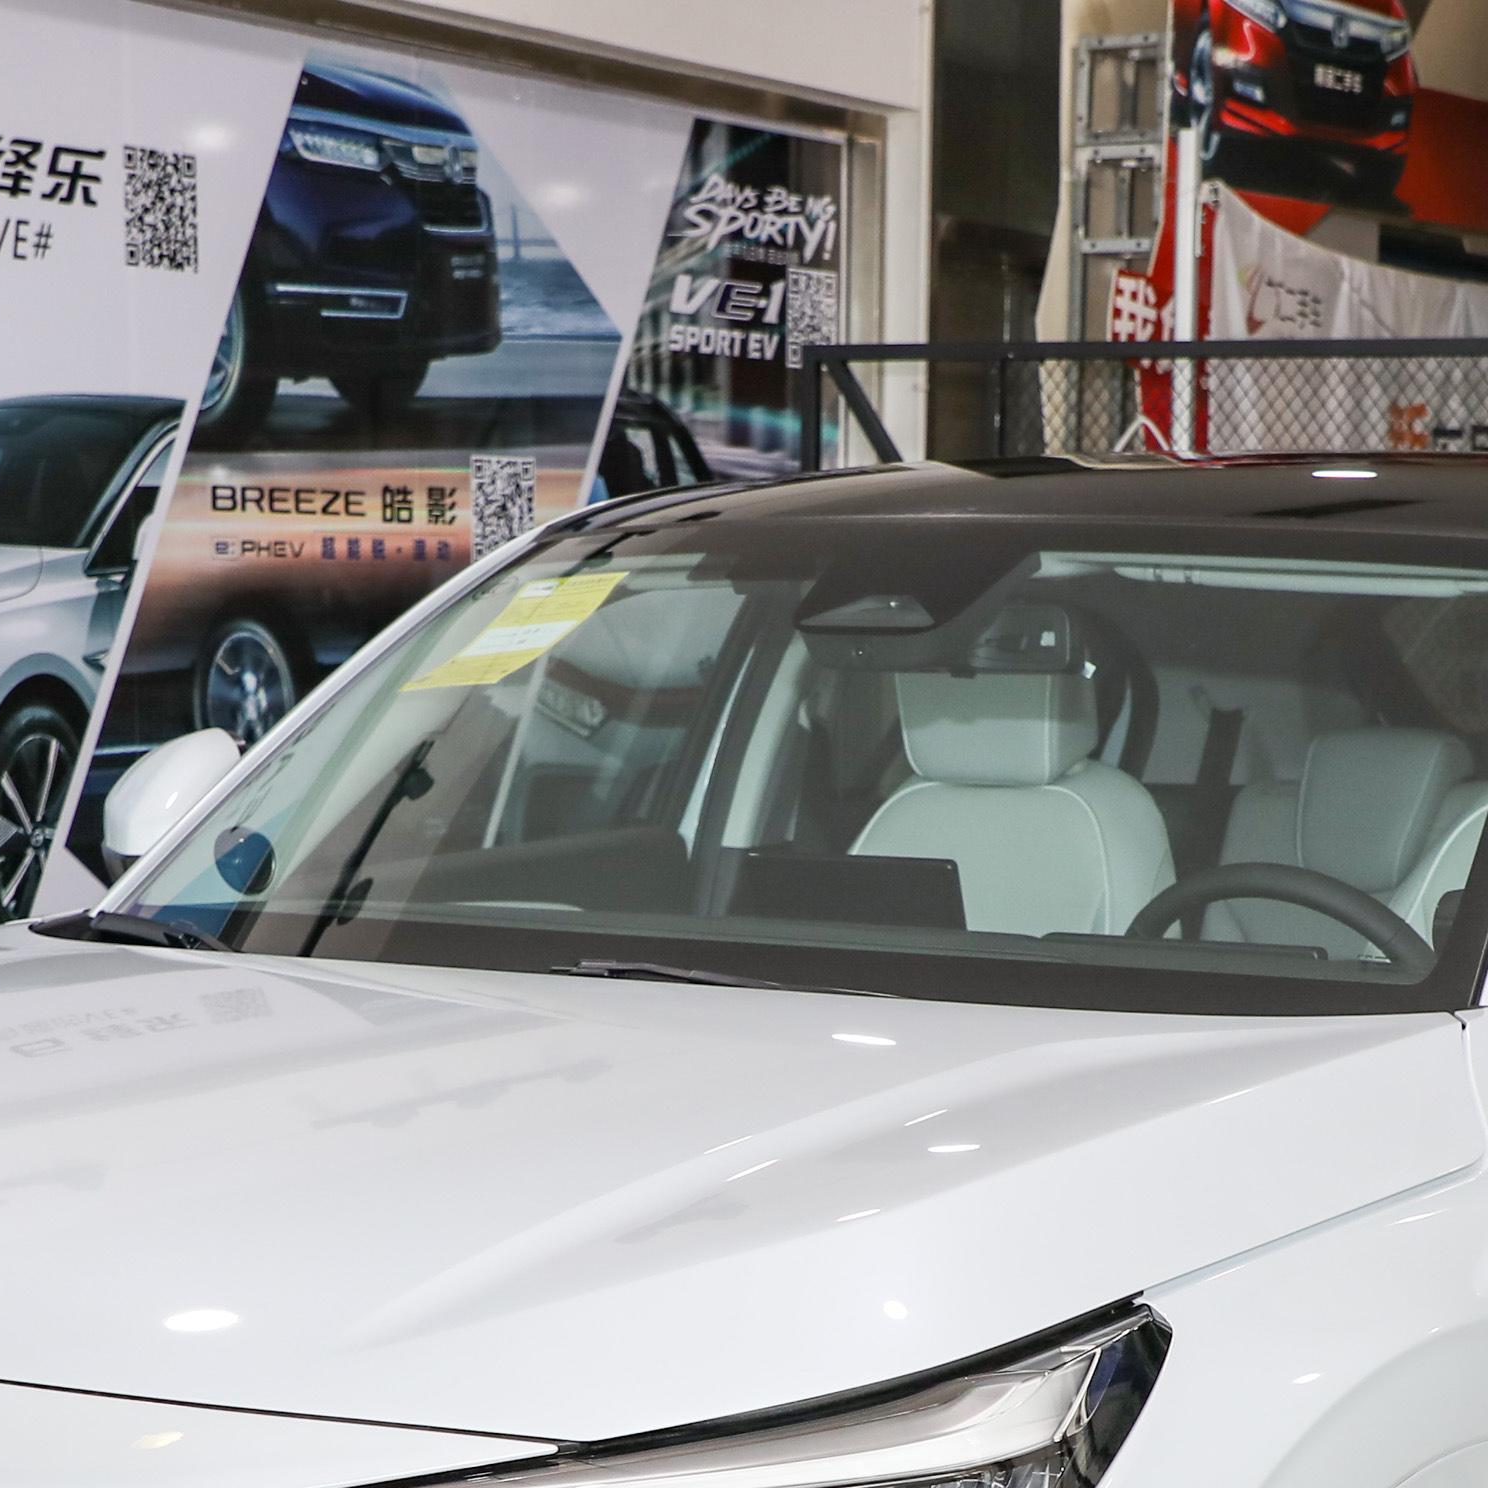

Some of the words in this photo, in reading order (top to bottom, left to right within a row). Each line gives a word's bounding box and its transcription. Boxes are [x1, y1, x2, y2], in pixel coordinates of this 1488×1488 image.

[669, 324, 746, 357] SPORT
[747, 333, 780, 361] EV
[211, 484, 367, 517] BREEZE
[382, 485, 458, 525] 皓影
